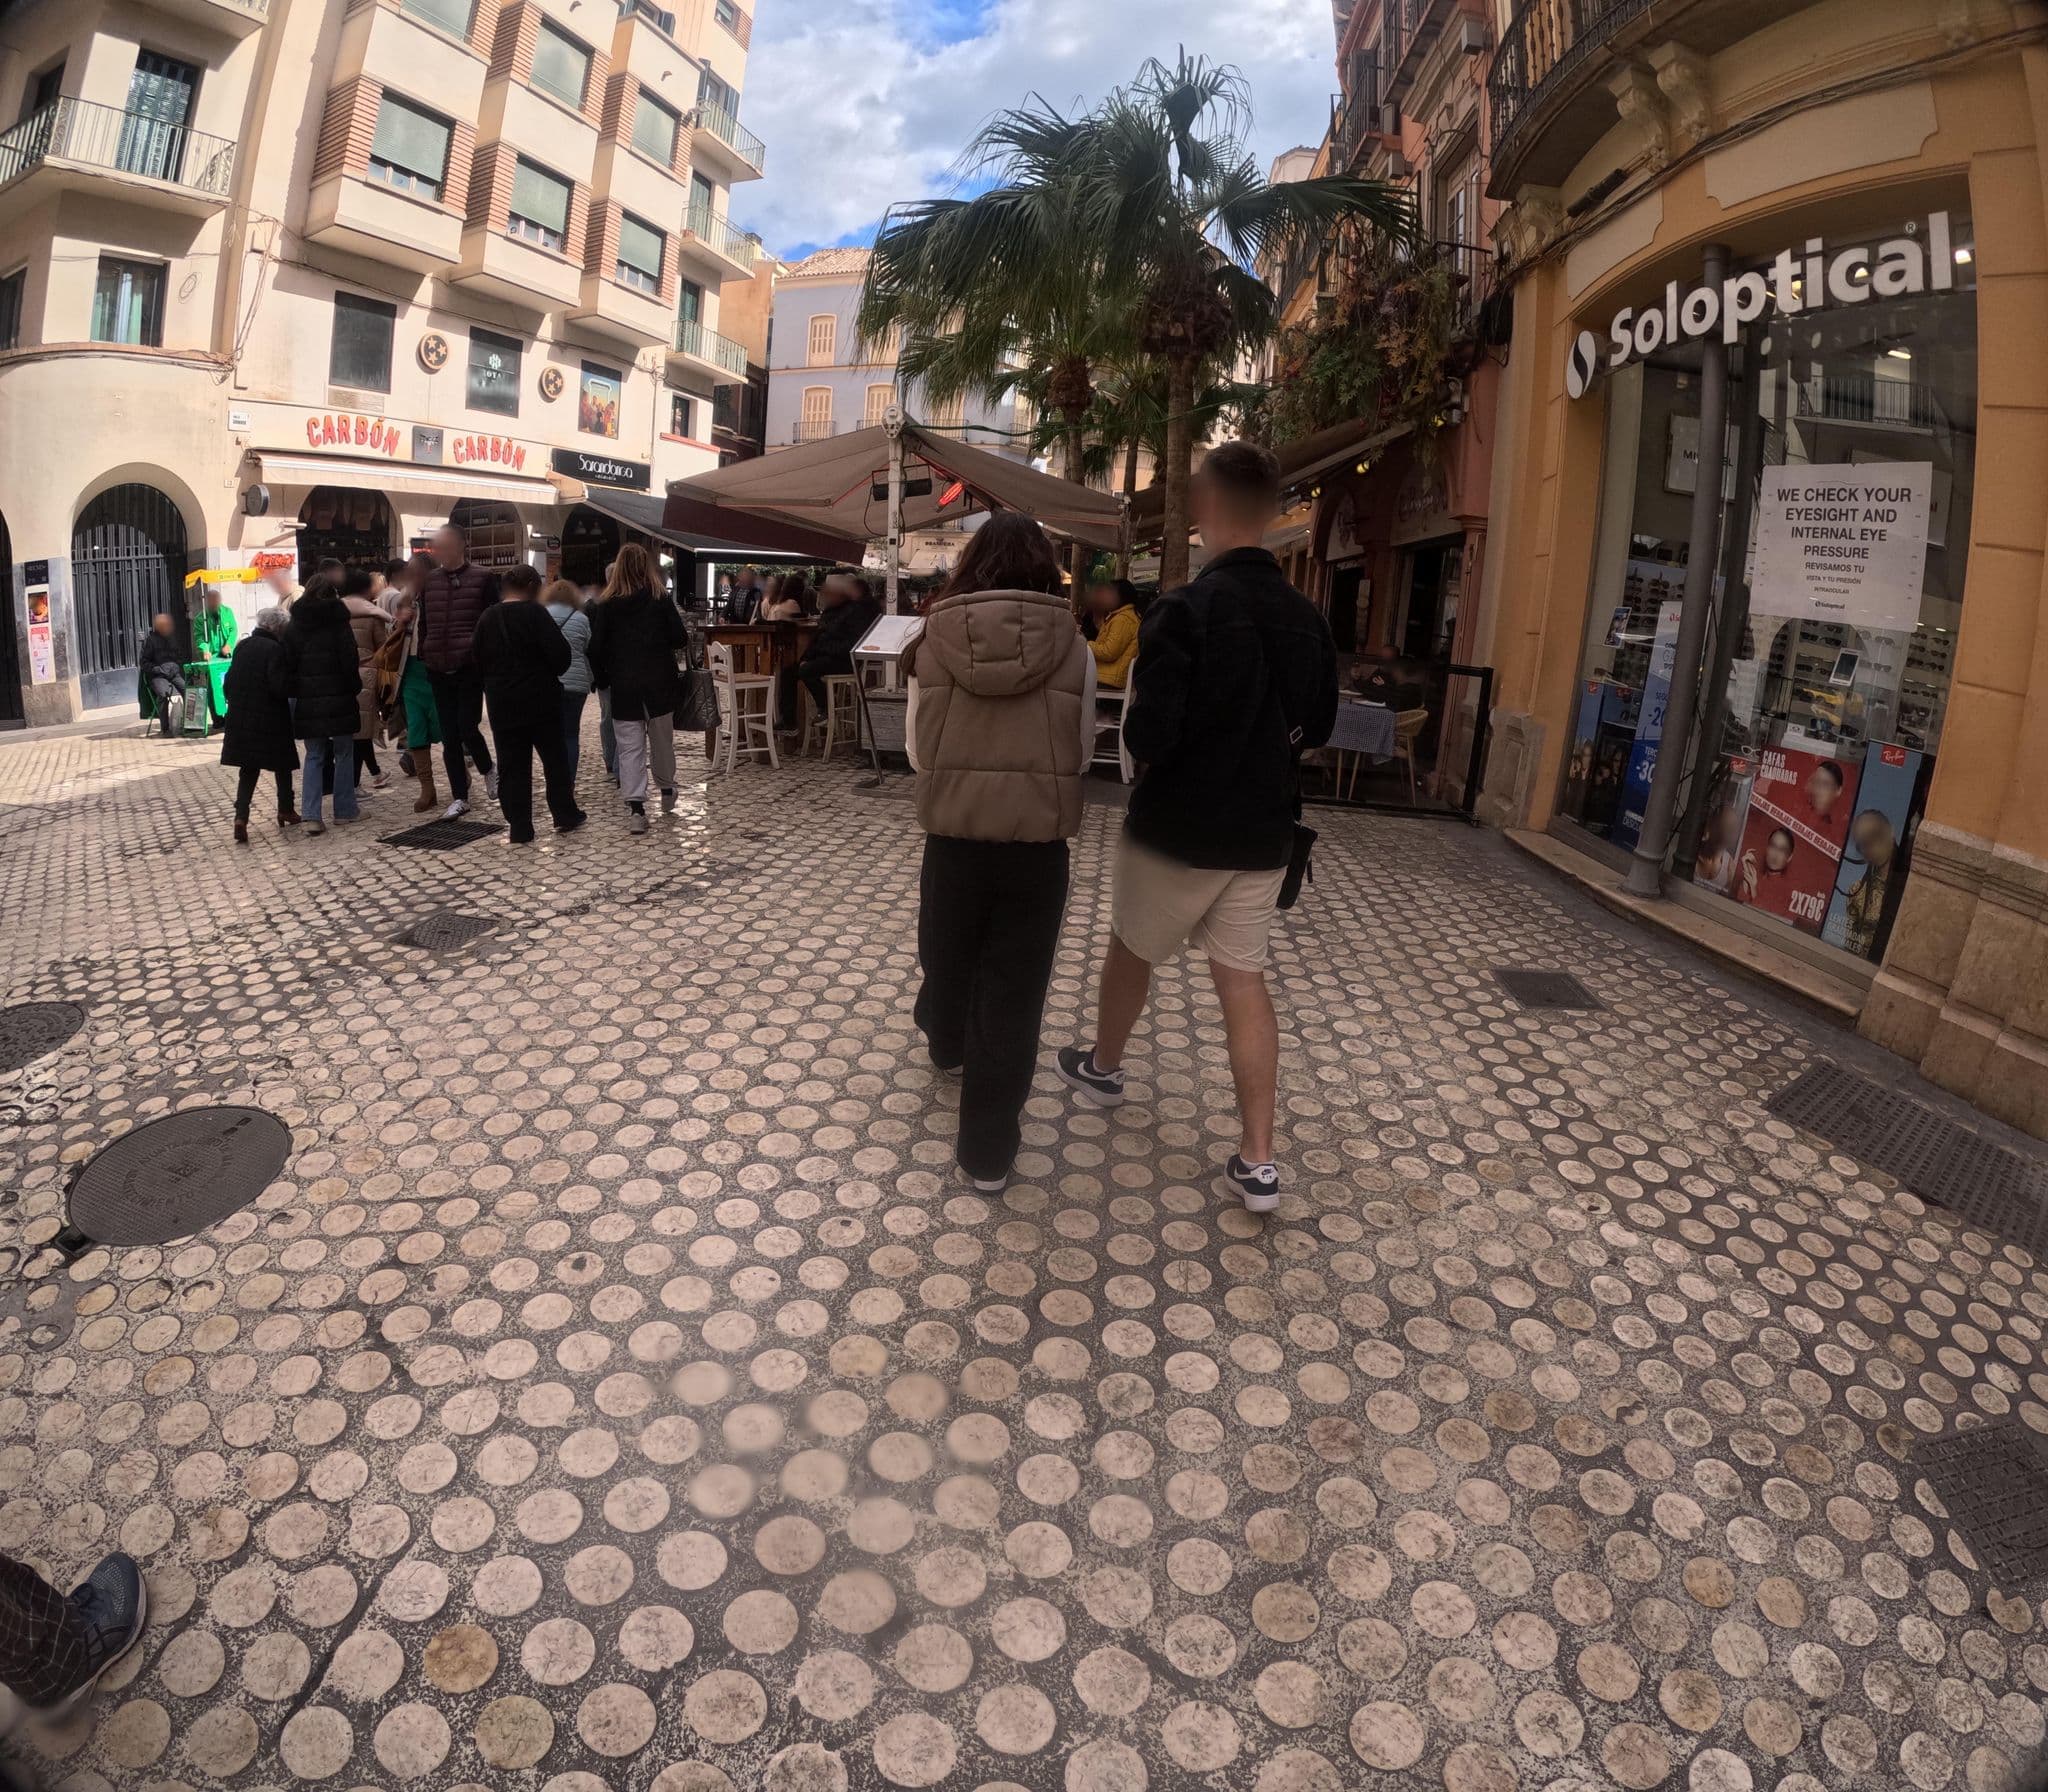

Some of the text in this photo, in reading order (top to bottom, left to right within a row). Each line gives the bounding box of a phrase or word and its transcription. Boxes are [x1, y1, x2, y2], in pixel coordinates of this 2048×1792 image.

[1610, 211, 1952, 367] Soloptical
[307, 415, 401, 456] CARBÓN
[453, 436, 527, 471] CARBÓN
[1777, 487, 1912, 503] WE CHECK YOUR
[1785, 508, 1898, 523] EYESIGHT AND
[1791, 526, 1888, 541] INTERNAL EYE
[1803, 545, 1869, 560] PRESSURE
[1805, 562, 1865, 574] REVISAMOS TU
